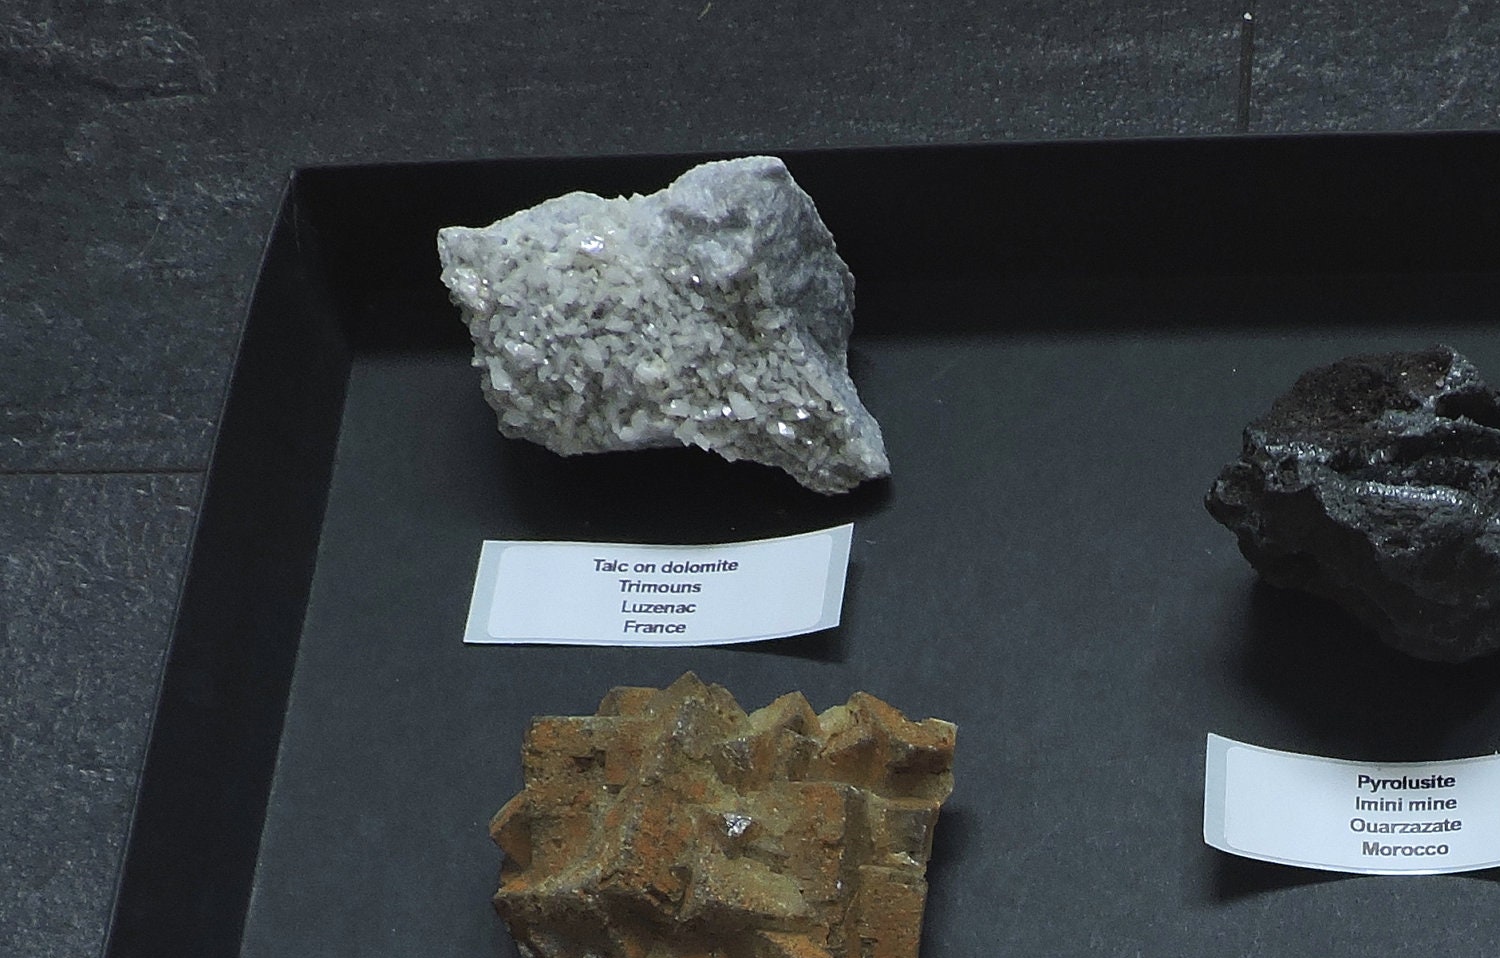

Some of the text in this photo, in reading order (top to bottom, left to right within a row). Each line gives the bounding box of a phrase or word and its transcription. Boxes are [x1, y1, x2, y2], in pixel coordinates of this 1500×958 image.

[593, 558, 739, 574] Talc on dolomite
[619, 579, 702, 594] Trimouns
[621, 600, 697, 614] Luzenac
[623, 620, 687, 634] France
[1357, 774, 1456, 793] Pyrolusite
[1355, 796, 1458, 812] Imini mine
[1350, 818, 1462, 834] Ouarzazate
[1362, 841, 1449, 857] Morocco
